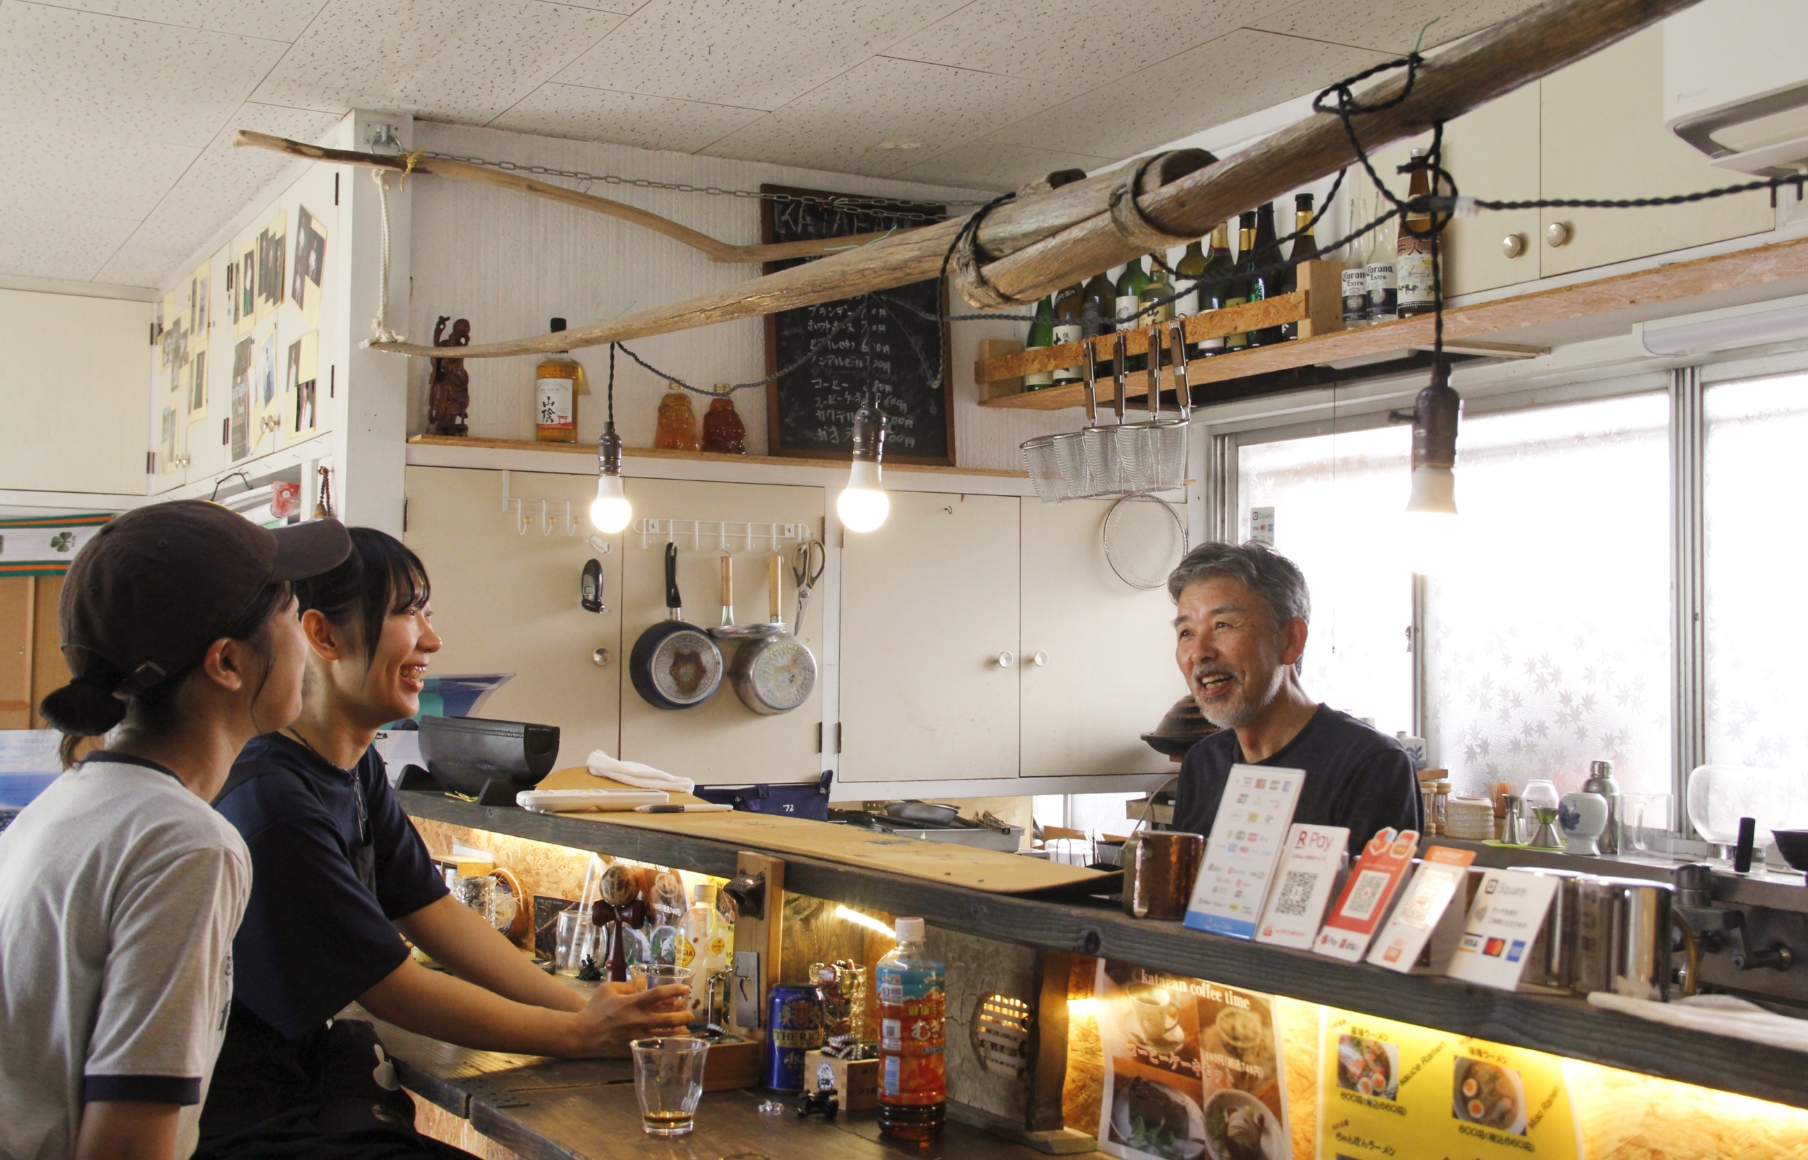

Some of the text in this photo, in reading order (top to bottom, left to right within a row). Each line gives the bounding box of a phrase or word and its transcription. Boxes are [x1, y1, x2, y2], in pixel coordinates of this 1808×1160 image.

[1342, 271, 1366, 282] Coron
[1367, 264, 1394, 276] Corona
[811, 379, 849, 390] コーヒー
[541, 395, 556, 423] 山陰
[1308, 832, 1334, 851] Pay
[1497, 882, 1527, 896] Square
[1463, 938, 1478, 947] VISA
[1189, 982, 1223, 1002] coffee
[1223, 990, 1251, 1010] time
[774, 1032, 799, 1041] THE
[1399, 1062, 1421, 1086] sauce
[1420, 1041, 1447, 1066] Ramen
[1528, 1085, 1560, 1130] Miso Ramen
